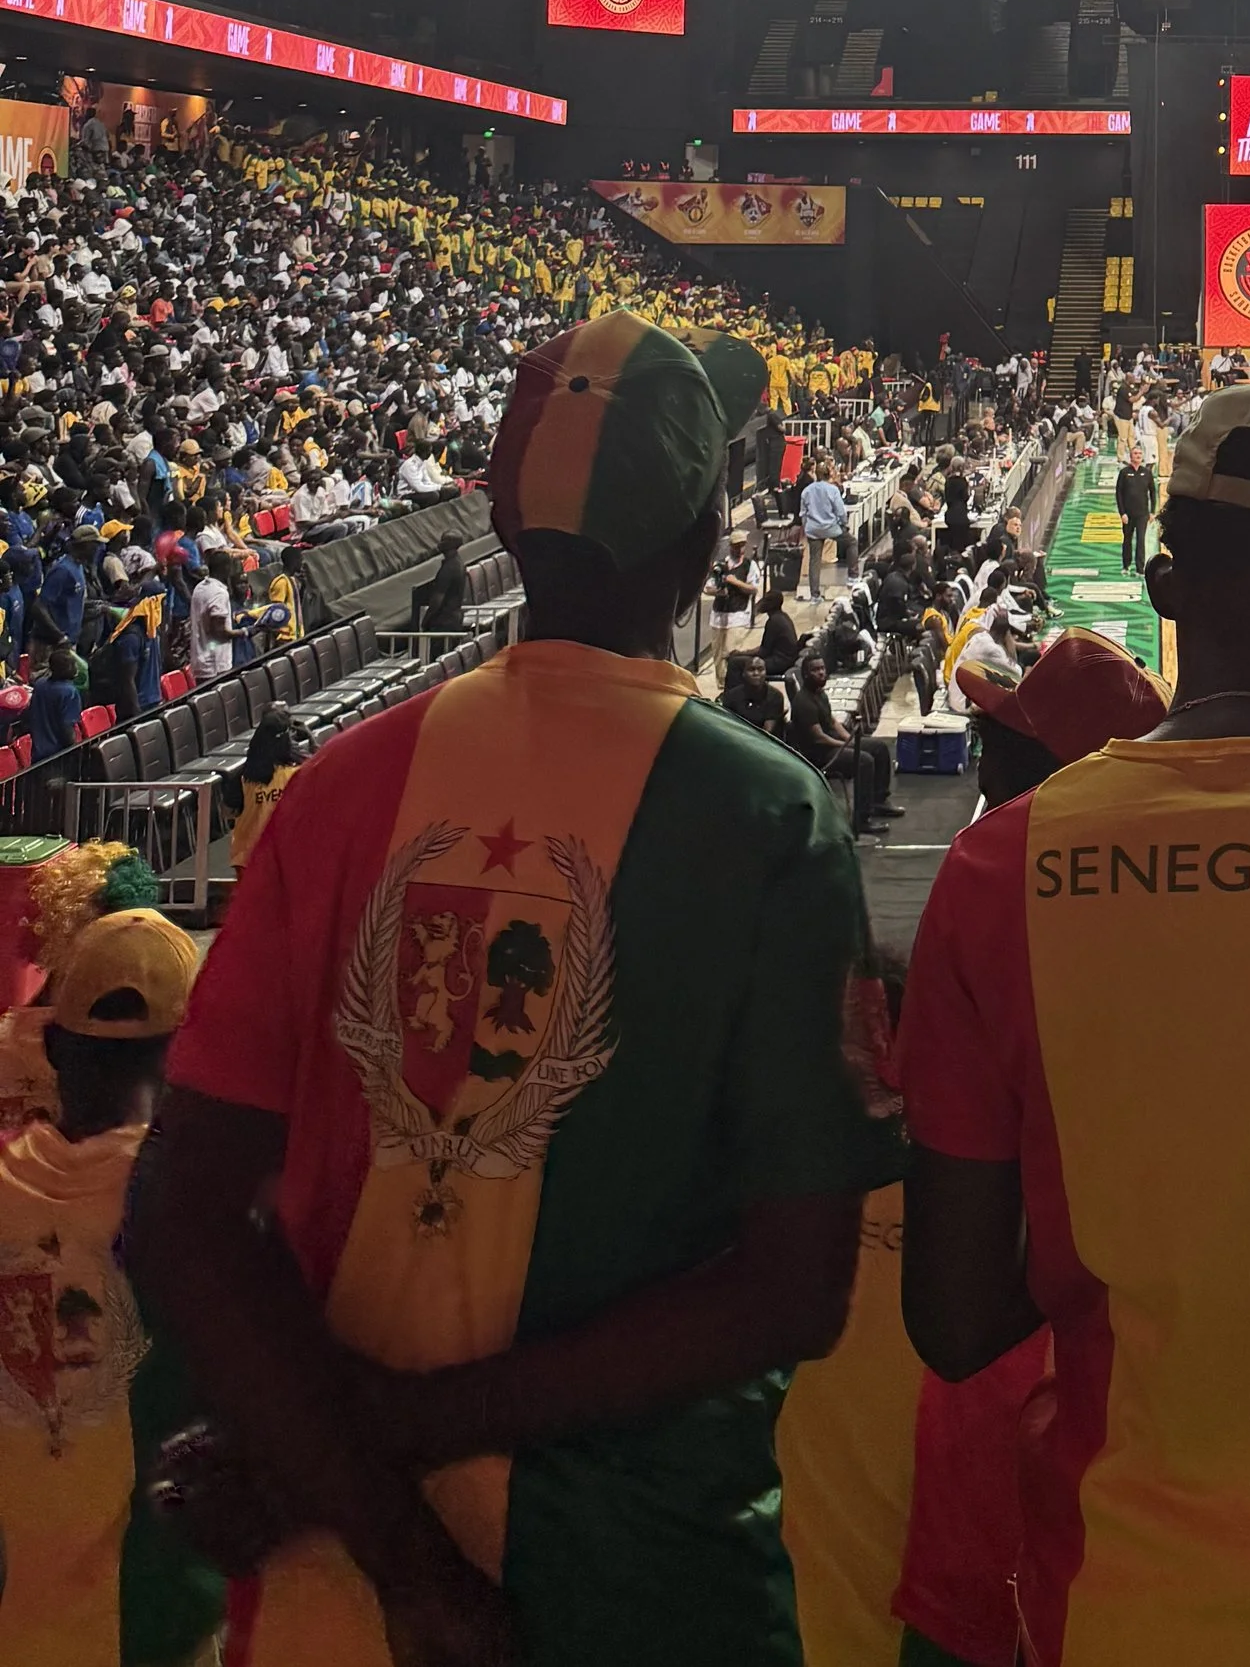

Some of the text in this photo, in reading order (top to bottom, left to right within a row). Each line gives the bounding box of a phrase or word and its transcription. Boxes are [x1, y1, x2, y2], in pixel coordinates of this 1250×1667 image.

[227, 22, 251, 56] GAME
[831, 111, 863, 131] GAME
[970, 111, 1001, 132] GAME
[1016, 154, 1038, 170] 111
[537, 1065, 568, 1085] UNE
